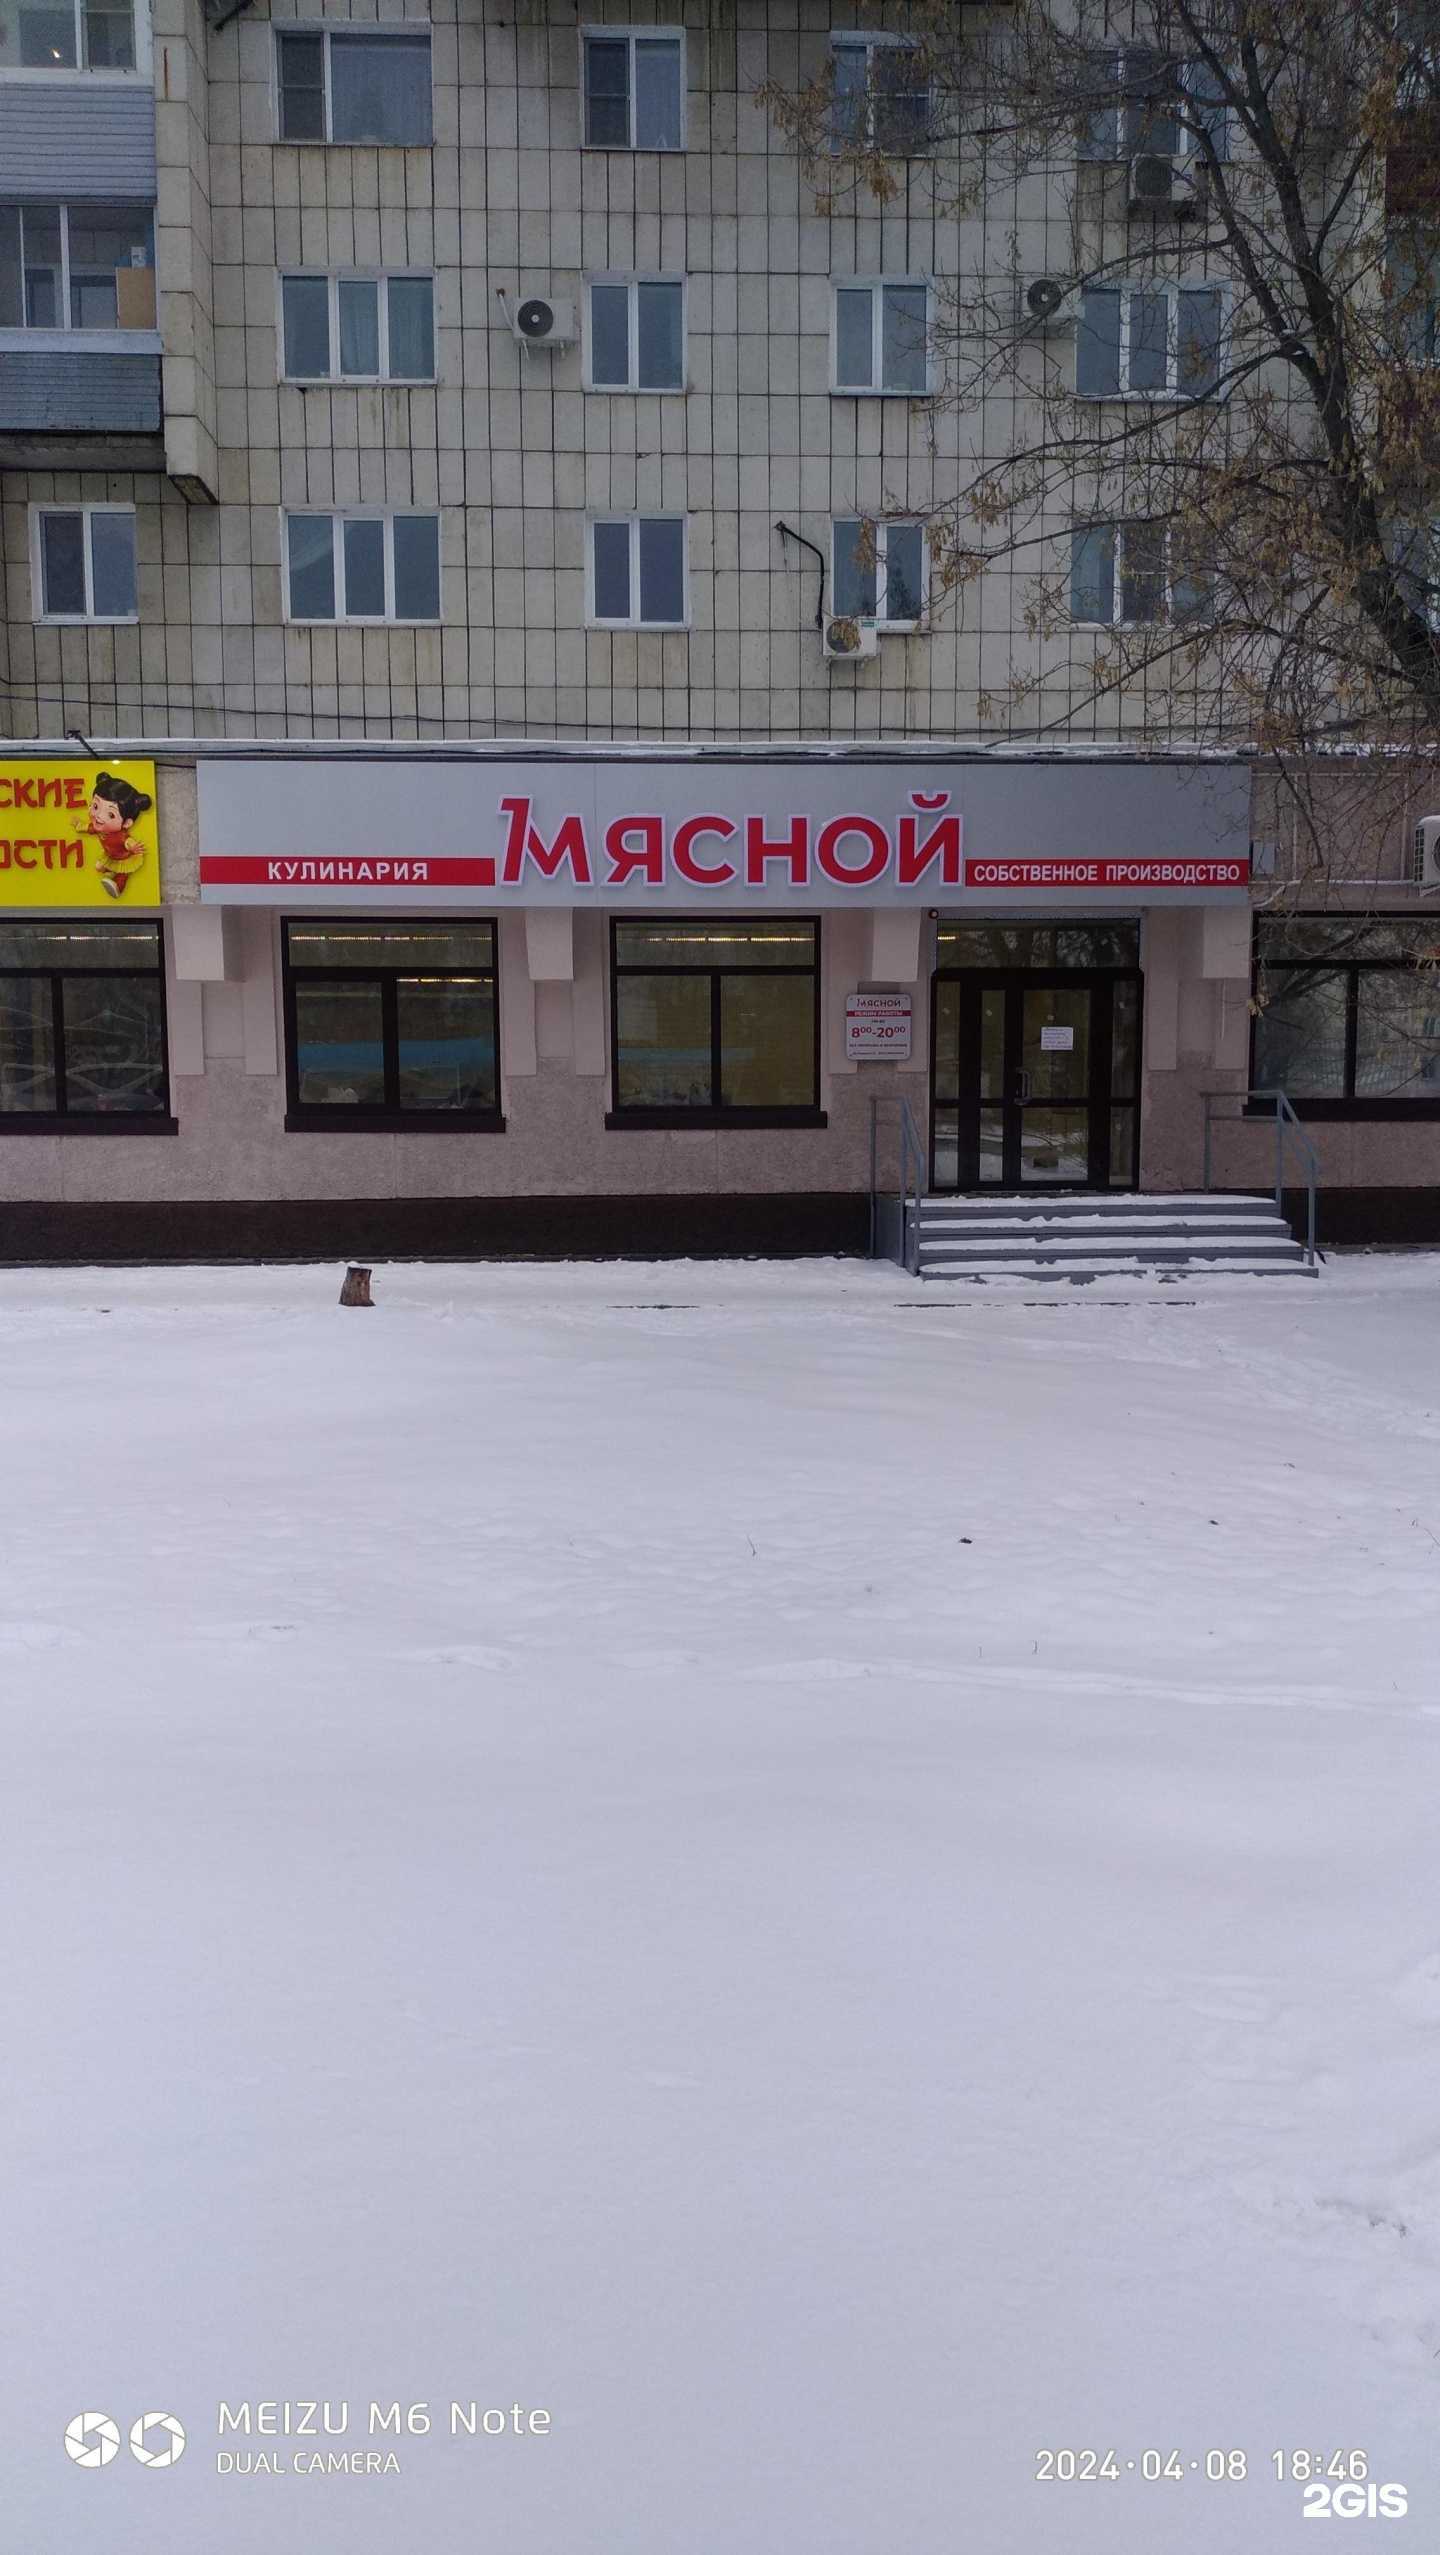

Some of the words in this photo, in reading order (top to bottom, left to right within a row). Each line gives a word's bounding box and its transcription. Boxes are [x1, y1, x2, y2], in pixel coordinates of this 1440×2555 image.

[267, 862, 429, 881] КУЛИНАРИЯ
[974, 865, 1098, 881] СОБСТВЕННОЕ
[1106, 864, 1240, 883] ПРОИЗВОДСТВО
